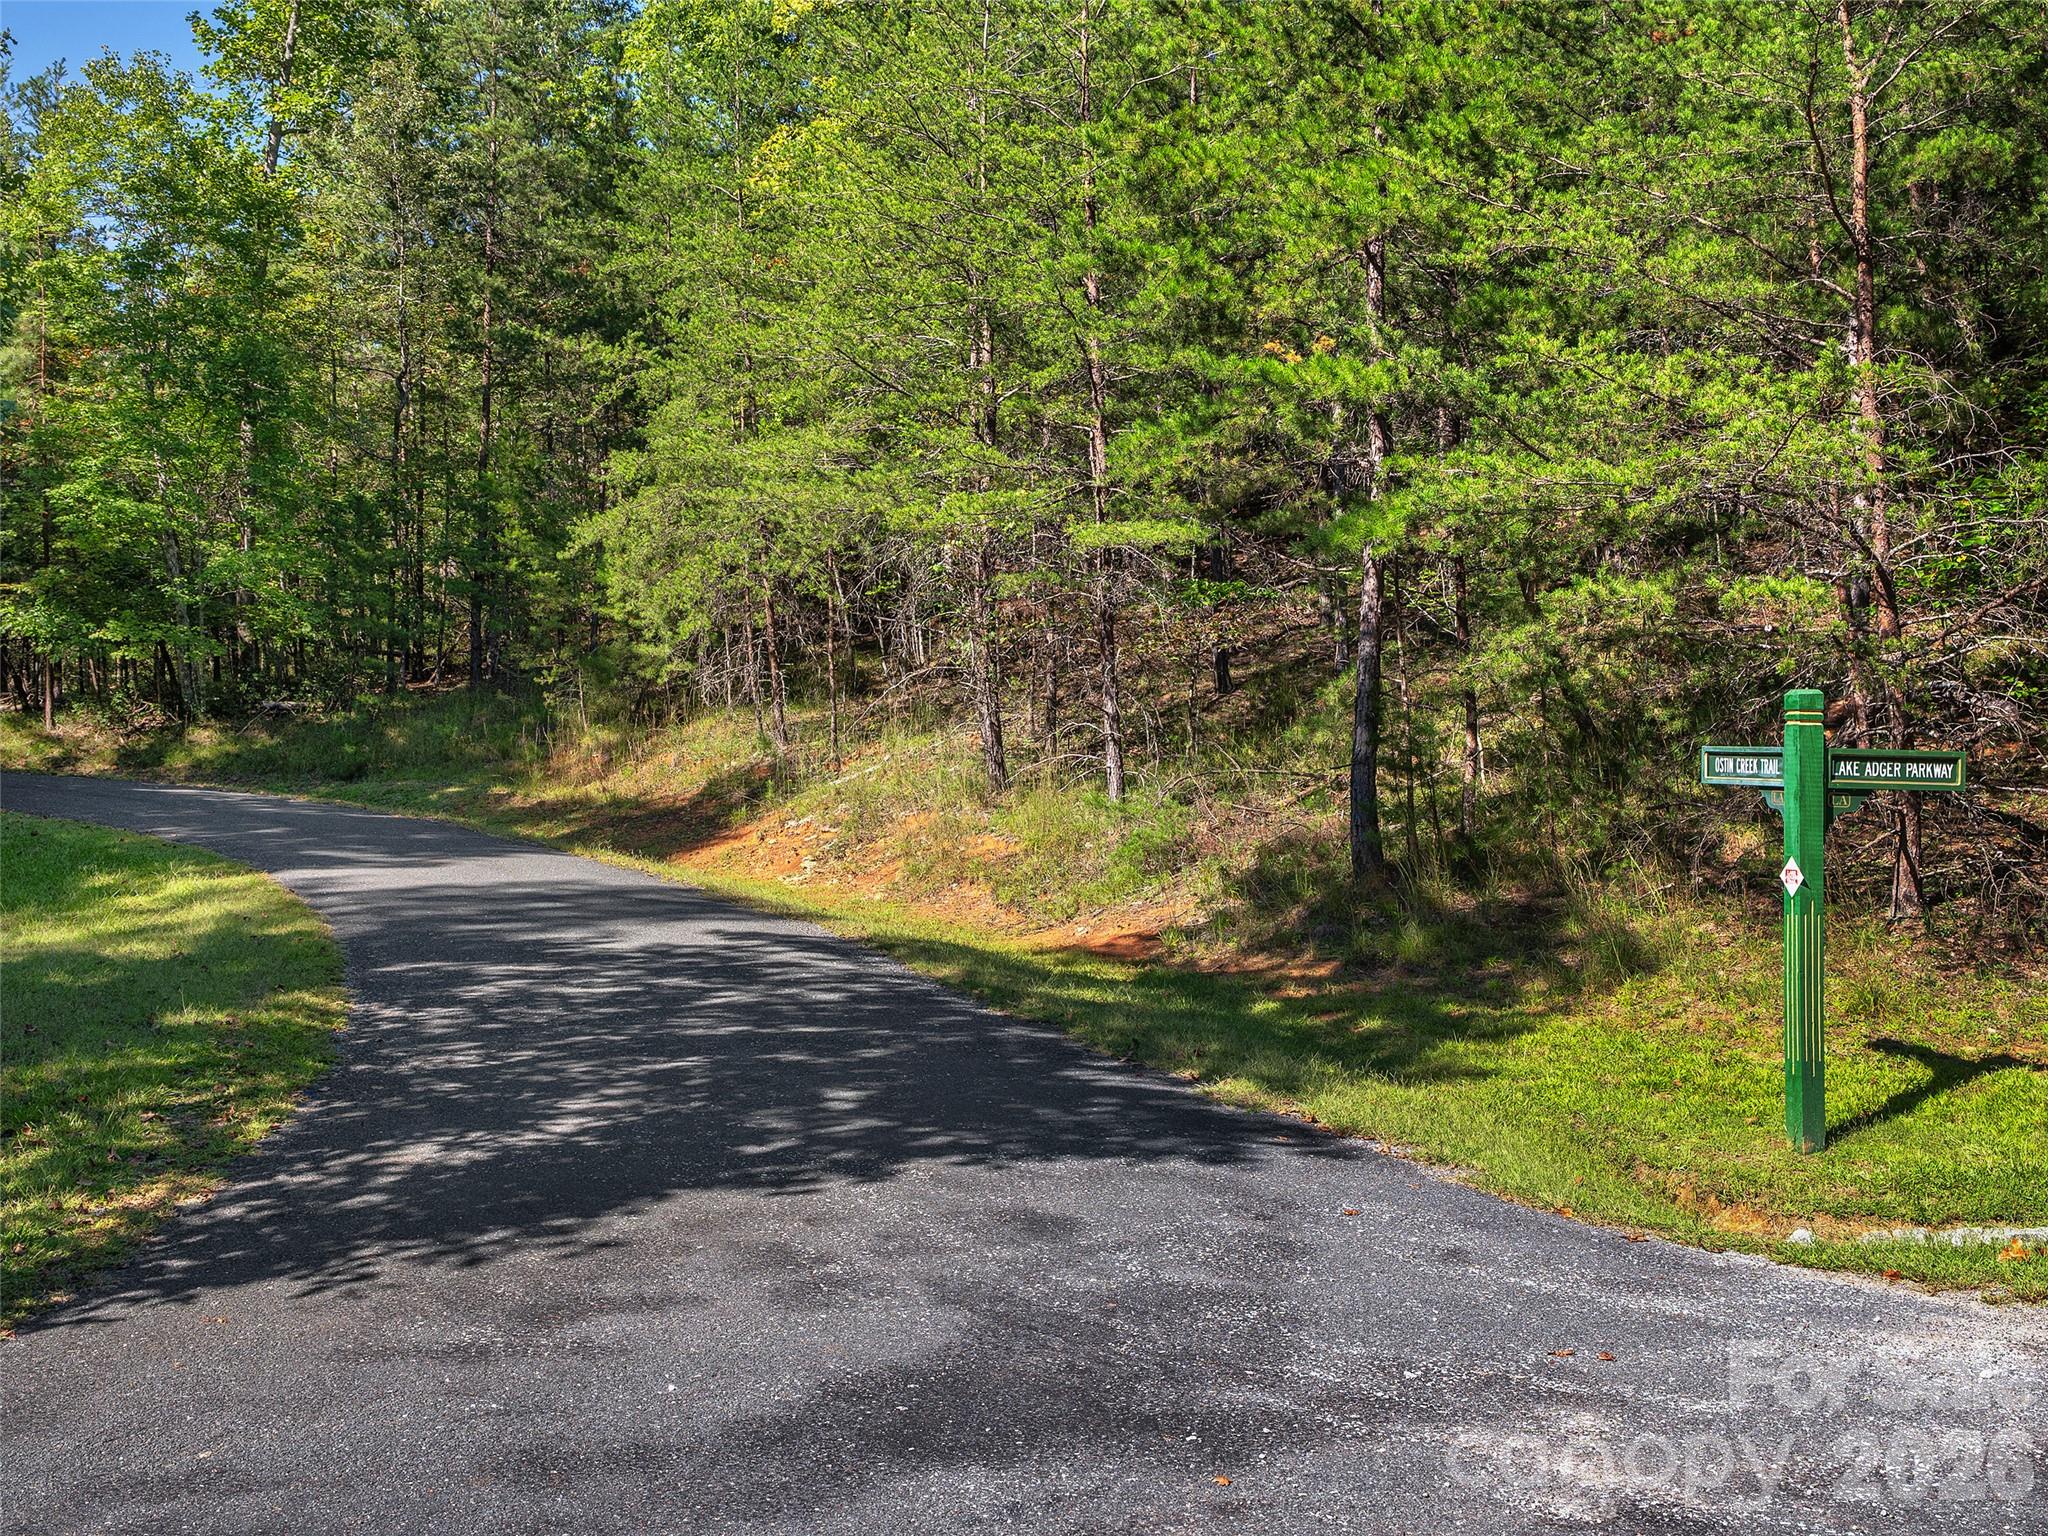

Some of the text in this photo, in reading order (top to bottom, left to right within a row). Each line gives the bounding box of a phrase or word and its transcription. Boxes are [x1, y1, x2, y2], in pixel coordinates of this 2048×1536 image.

[1715, 757, 1780, 775] OSTIN CREEK TRAIL
[1832, 759, 1954, 779] LAKE ADGER PARKWAY
